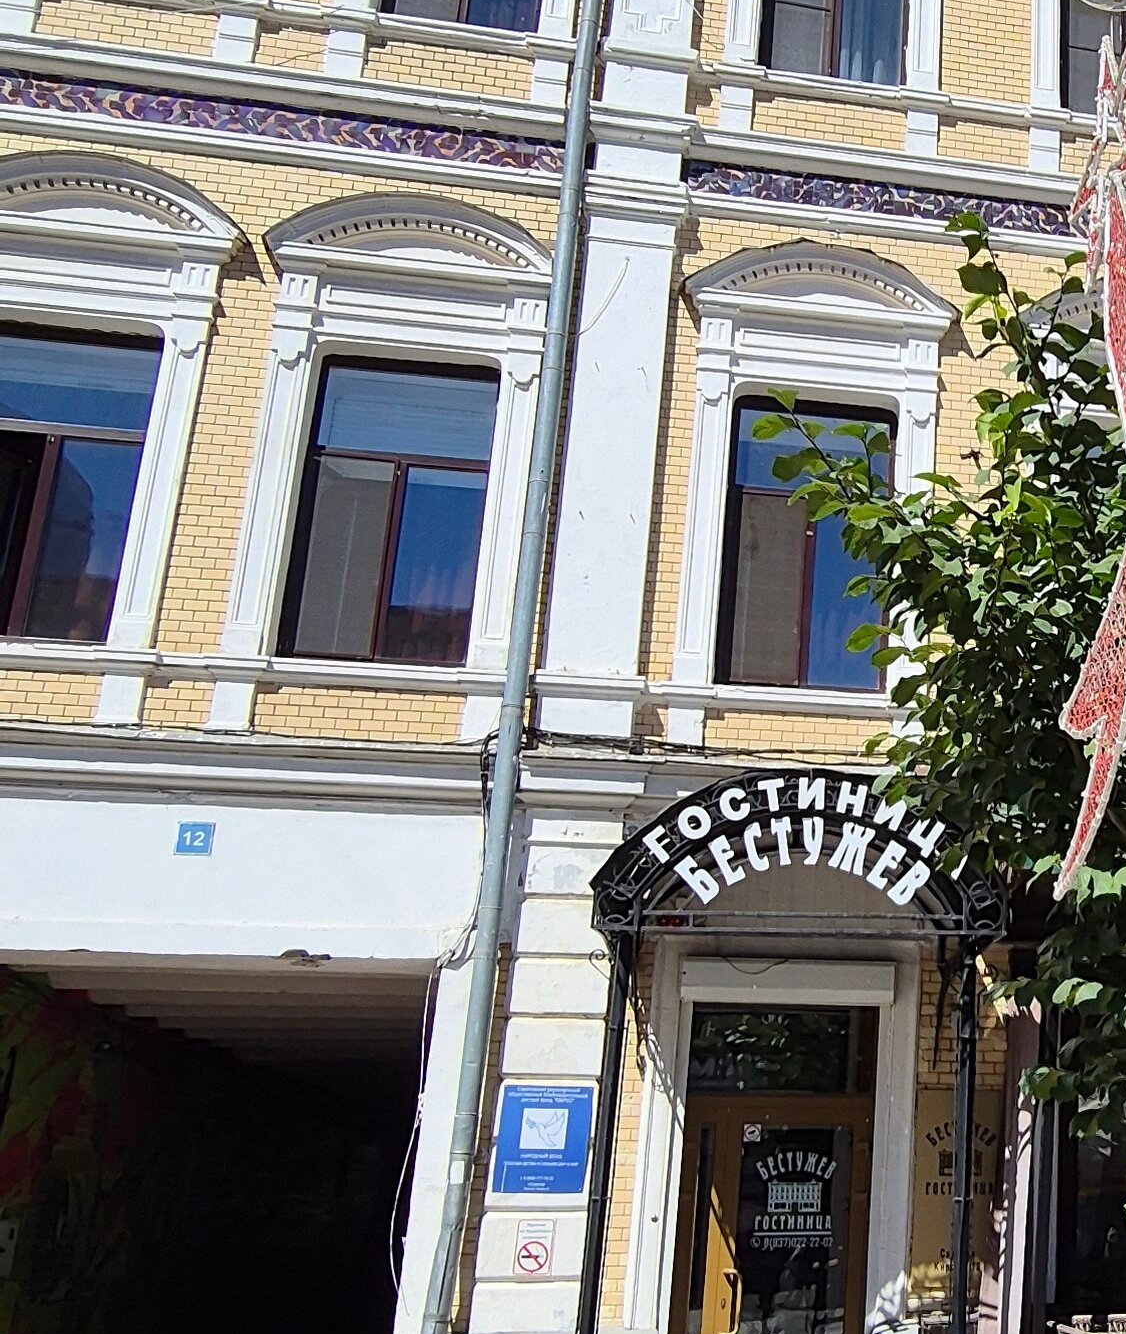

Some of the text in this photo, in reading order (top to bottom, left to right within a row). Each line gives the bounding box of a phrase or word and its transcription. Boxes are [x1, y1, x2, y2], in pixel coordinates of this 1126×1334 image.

[183, 830, 206, 847] 12
[642, 777, 969, 881] ГОСТИНИЦ
[673, 816, 931, 906] БЕСТУЖЕВ
[756, 1151, 838, 1180] БЕСТУЖЕВ
[755, 1215, 832, 1230] ГОСТИНИЦА
